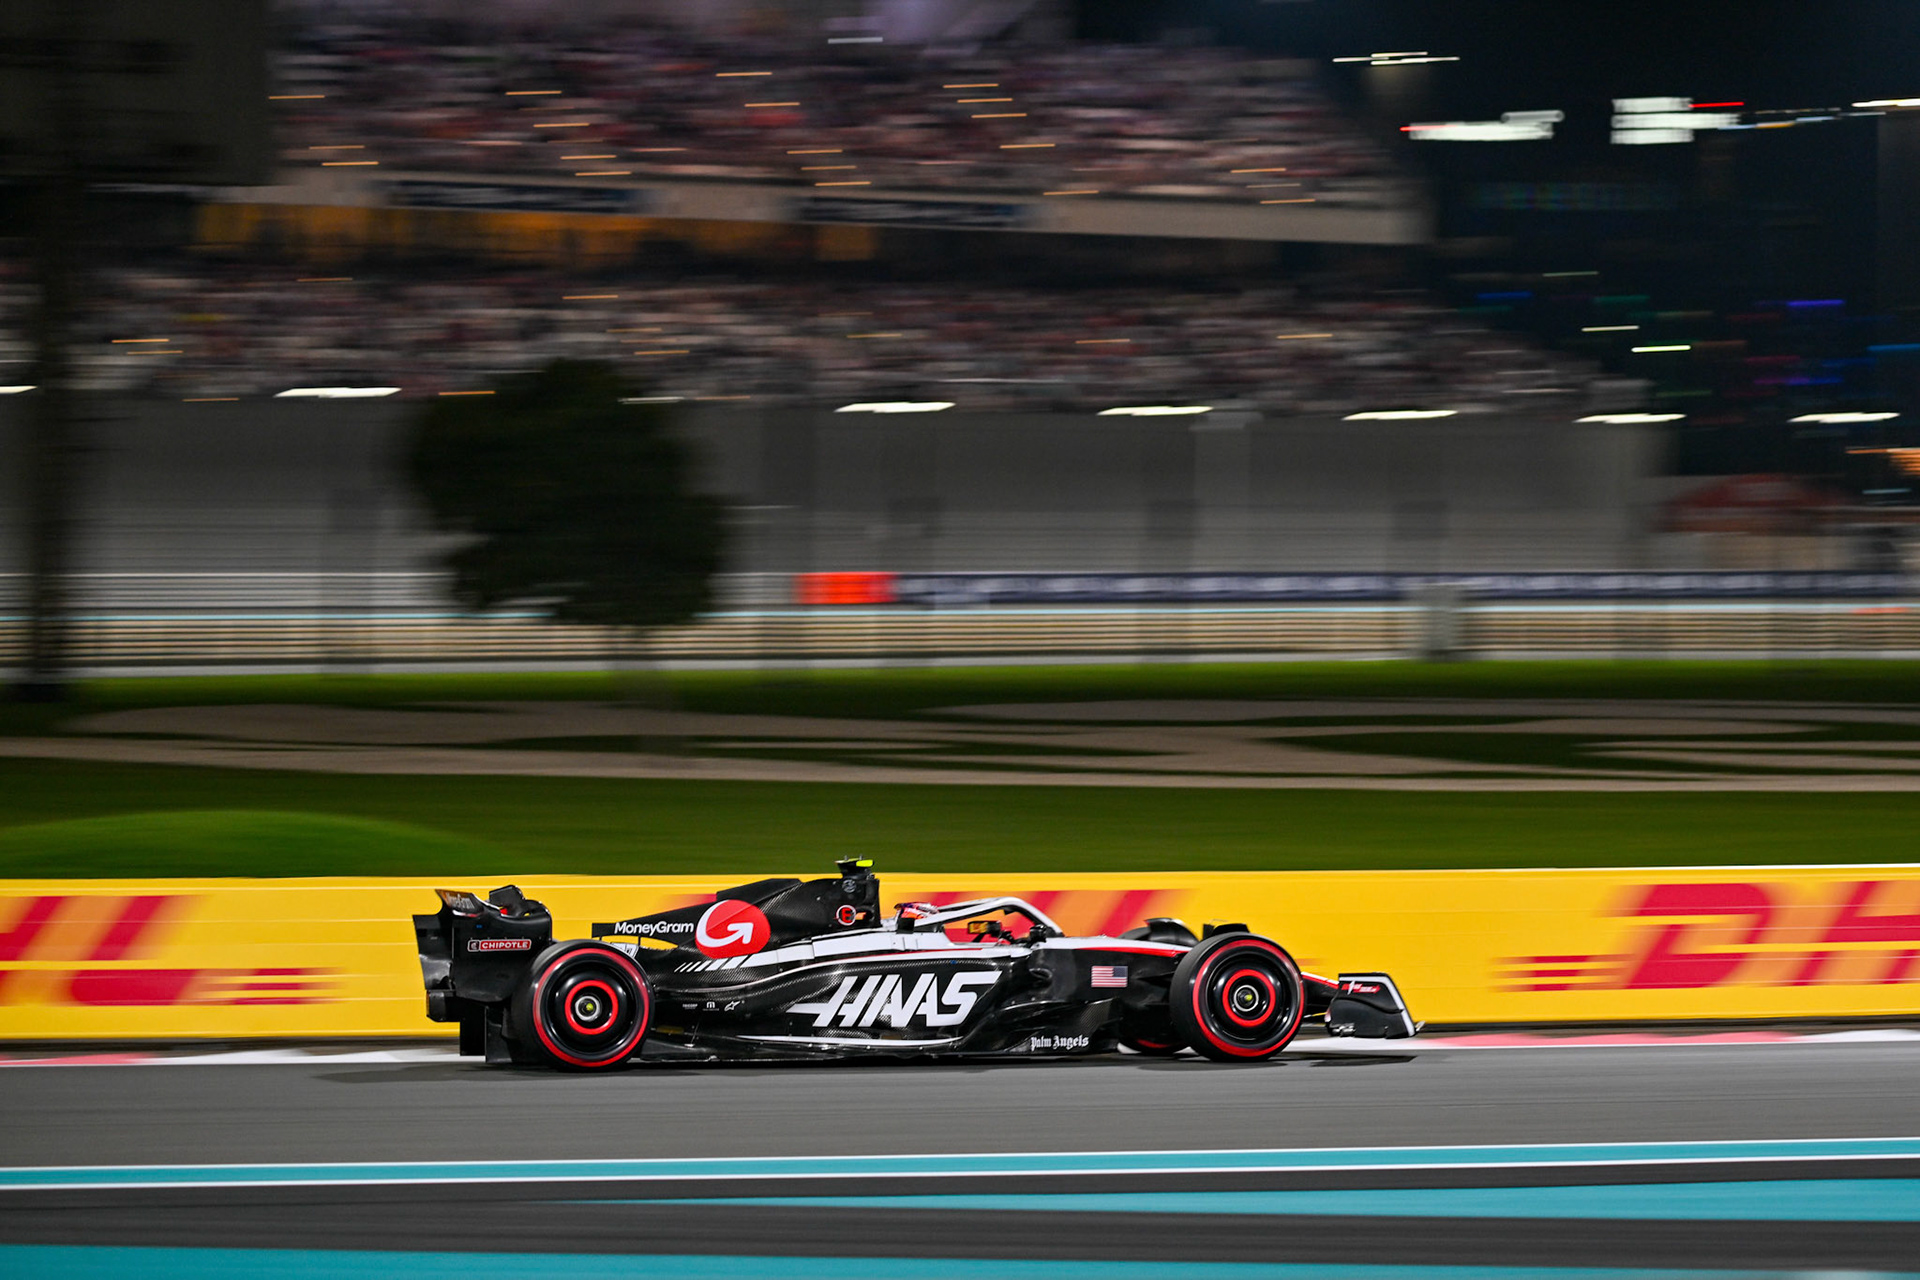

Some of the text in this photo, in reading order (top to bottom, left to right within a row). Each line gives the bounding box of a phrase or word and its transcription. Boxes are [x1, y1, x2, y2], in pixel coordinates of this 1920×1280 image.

[613, 920, 695, 937] MoneyGram
[481, 941, 529, 950] CHIPOTLE
[786, 970, 1003, 1028] HAAS
[1030, 1034, 1090, 1052] Palm Angels
